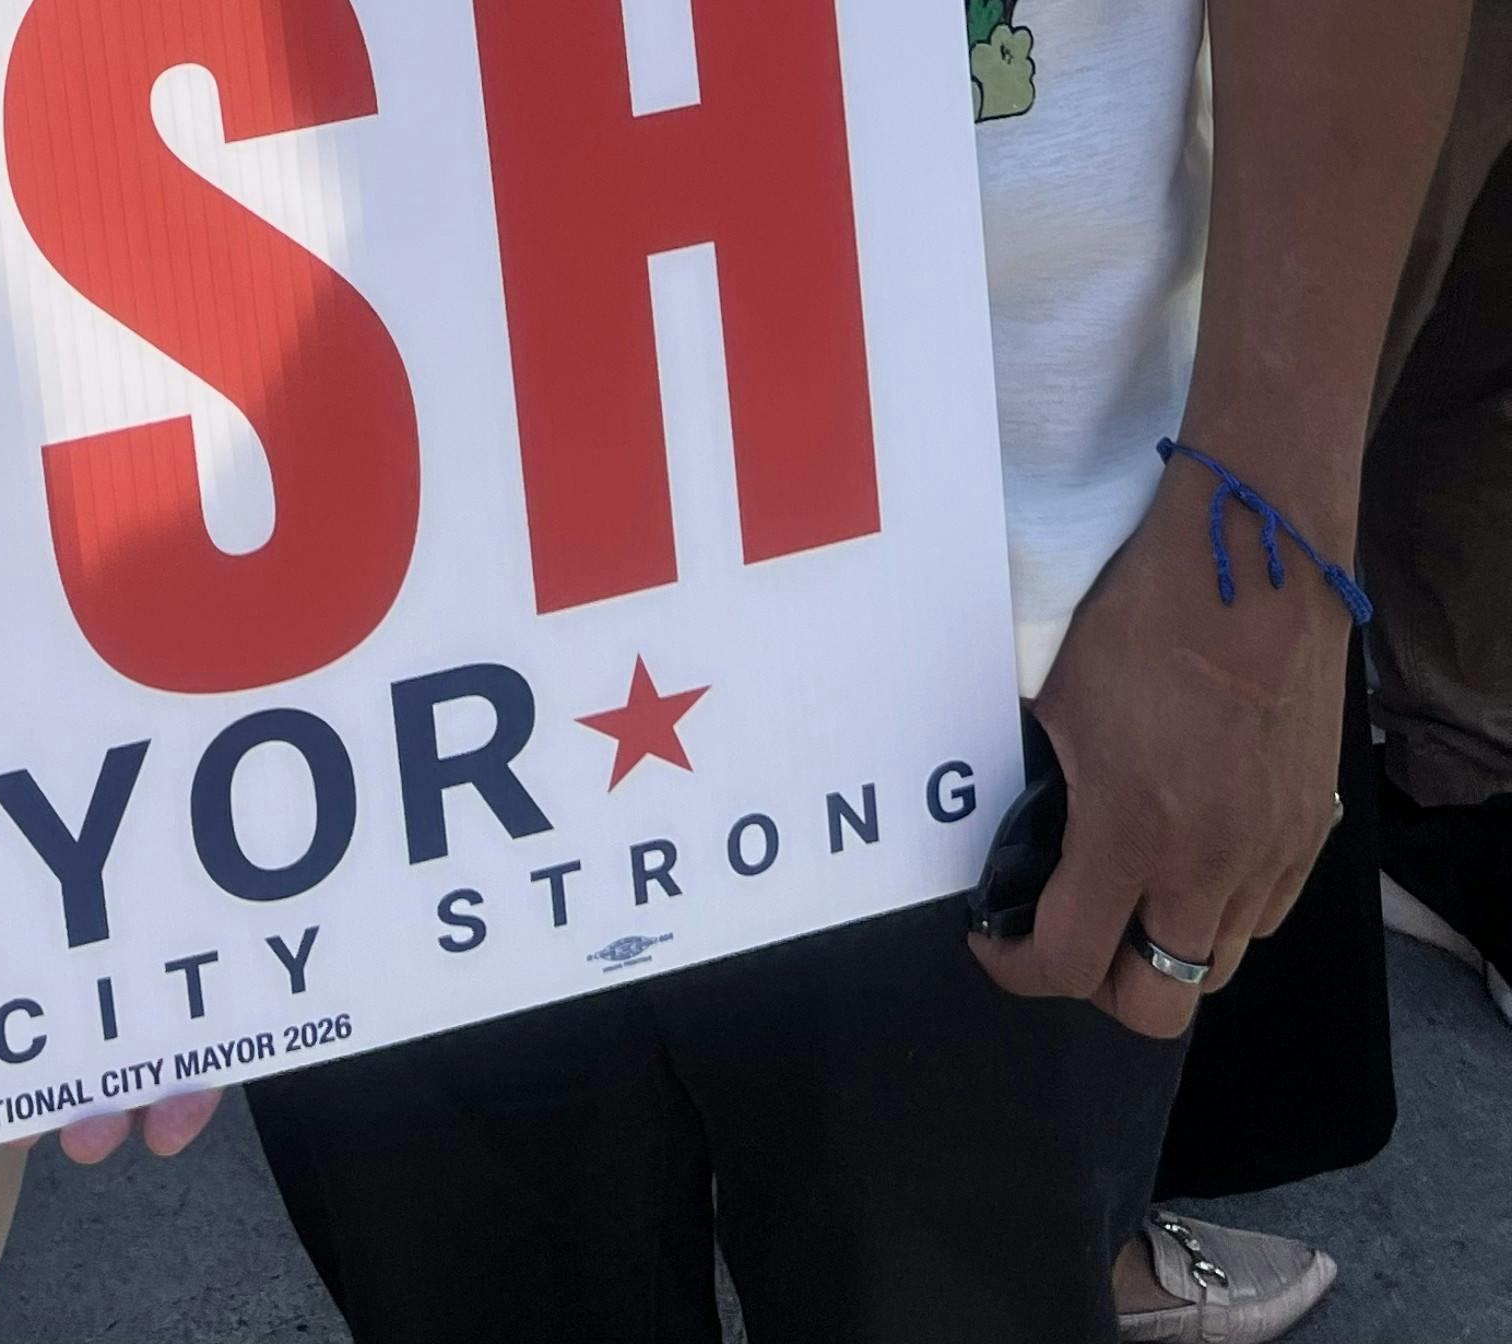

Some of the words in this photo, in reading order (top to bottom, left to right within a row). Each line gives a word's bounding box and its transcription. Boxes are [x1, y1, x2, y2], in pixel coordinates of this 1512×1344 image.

[437, 759, 978, 953] STRONG
[101, 1058, 164, 1098] CITY
[175, 1032, 276, 1080] MAYOR
[284, 1013, 353, 1053] 2026
